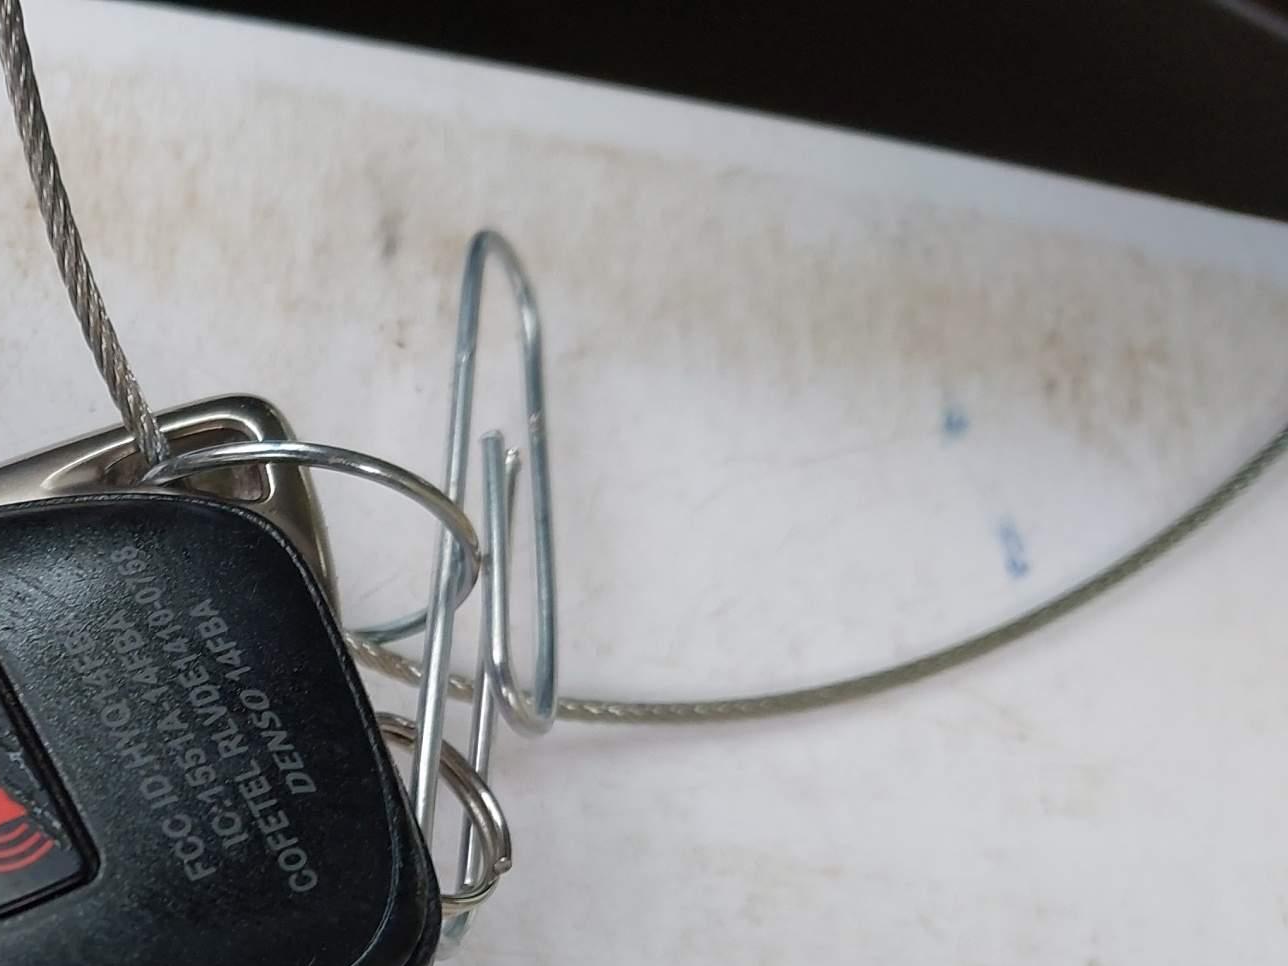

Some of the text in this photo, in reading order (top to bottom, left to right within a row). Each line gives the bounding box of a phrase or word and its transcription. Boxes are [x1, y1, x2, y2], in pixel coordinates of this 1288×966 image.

[190, 597, 318, 795] DENSO 14FBA
[160, 811, 217, 882] FCC
[233, 759, 320, 895] COFETEL
